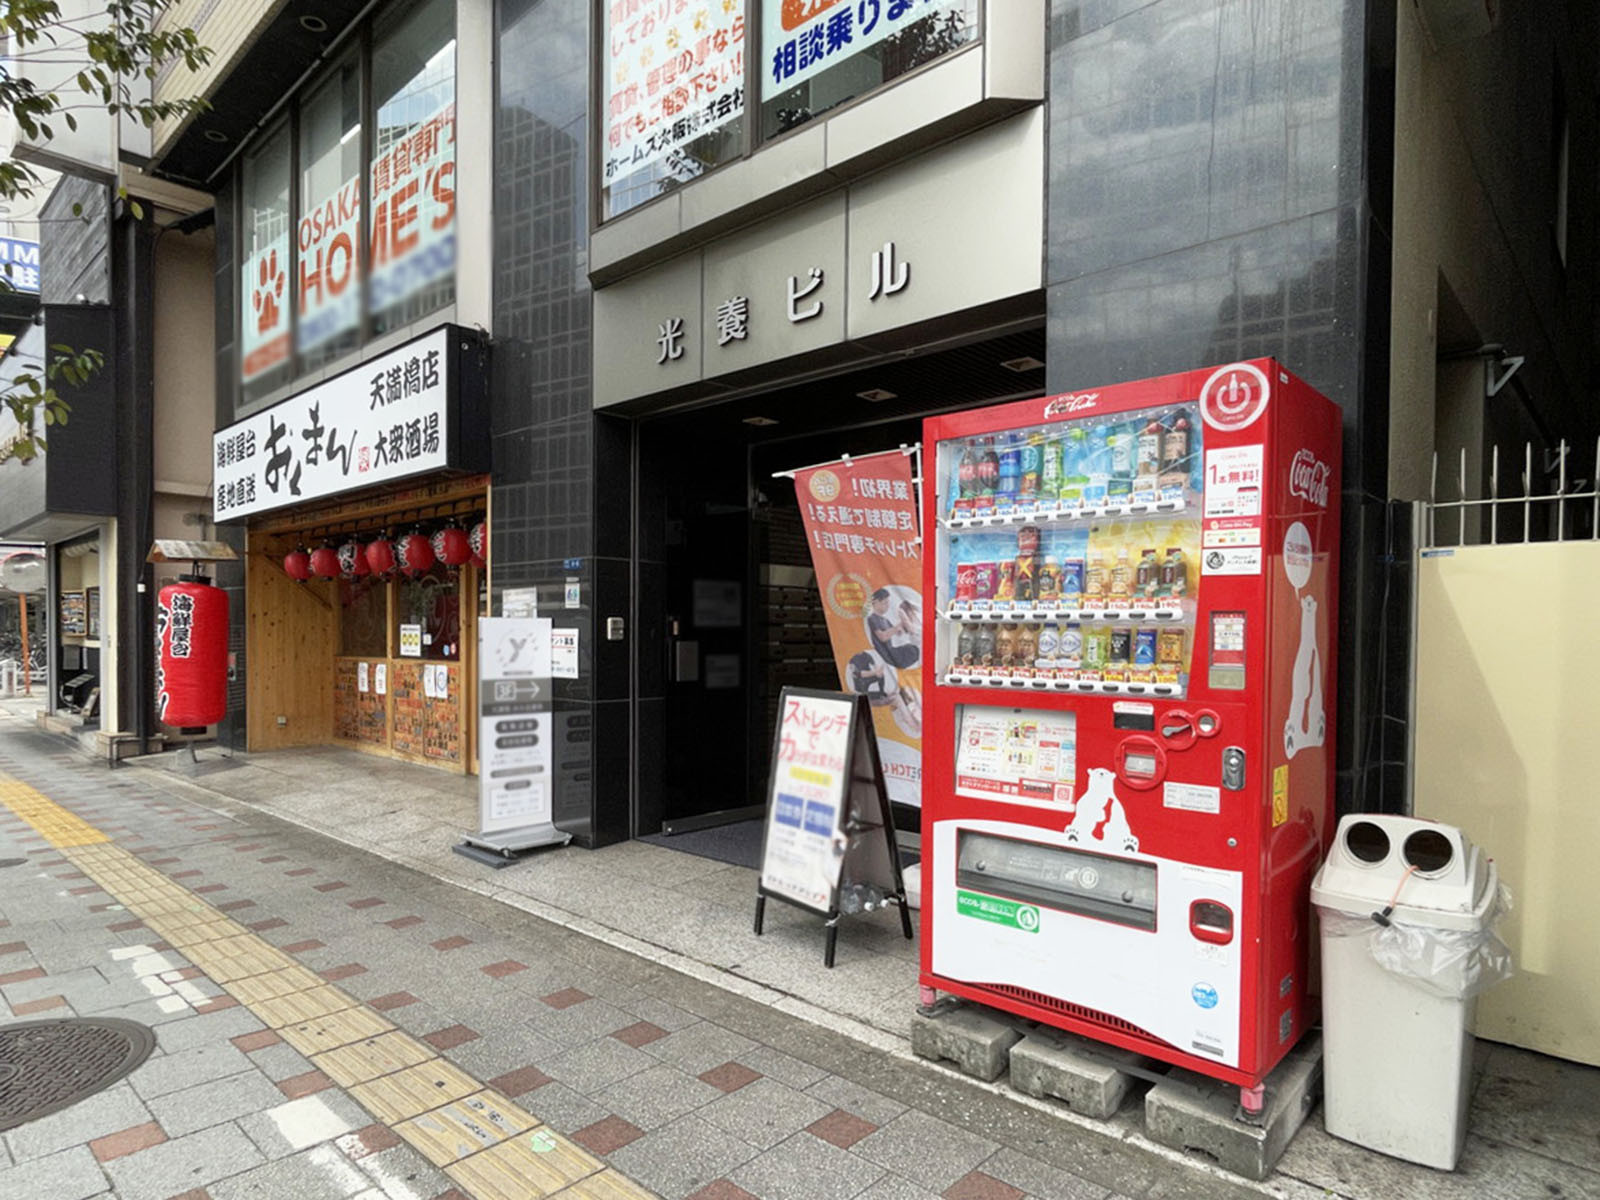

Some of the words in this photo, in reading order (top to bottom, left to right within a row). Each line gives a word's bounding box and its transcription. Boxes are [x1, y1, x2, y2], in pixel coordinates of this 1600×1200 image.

[773, 0, 931, 84] 相談乗りま
[299, 177, 361, 253] OSAKA
[299, 160, 456, 318] HOME'S
[370, 350, 440, 411] 天満橋店
[374, 412, 440, 469] 大衆酒場
[171, 594, 193, 657] 海鮮屋台
[783, 700, 848, 734] ストレッチ
